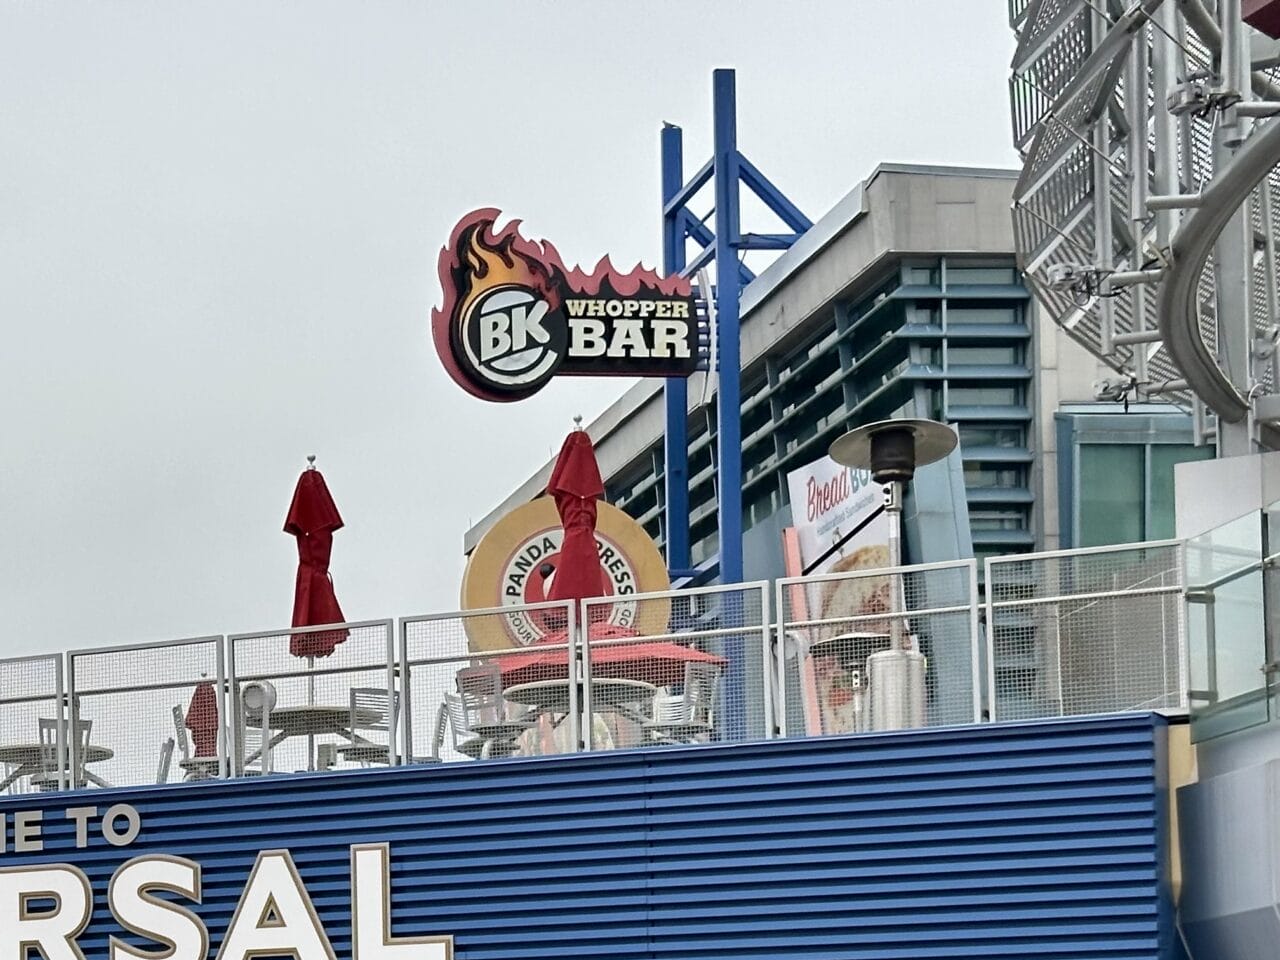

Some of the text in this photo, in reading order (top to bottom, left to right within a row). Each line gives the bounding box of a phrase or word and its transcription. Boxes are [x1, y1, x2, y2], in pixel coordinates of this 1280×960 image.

[566, 299, 689, 318] WHOPPER
[479, 299, 551, 364] BK
[568, 319, 691, 358] BAR
[506, 537, 557, 598] PANDA
[66, 803, 141, 848] TO
